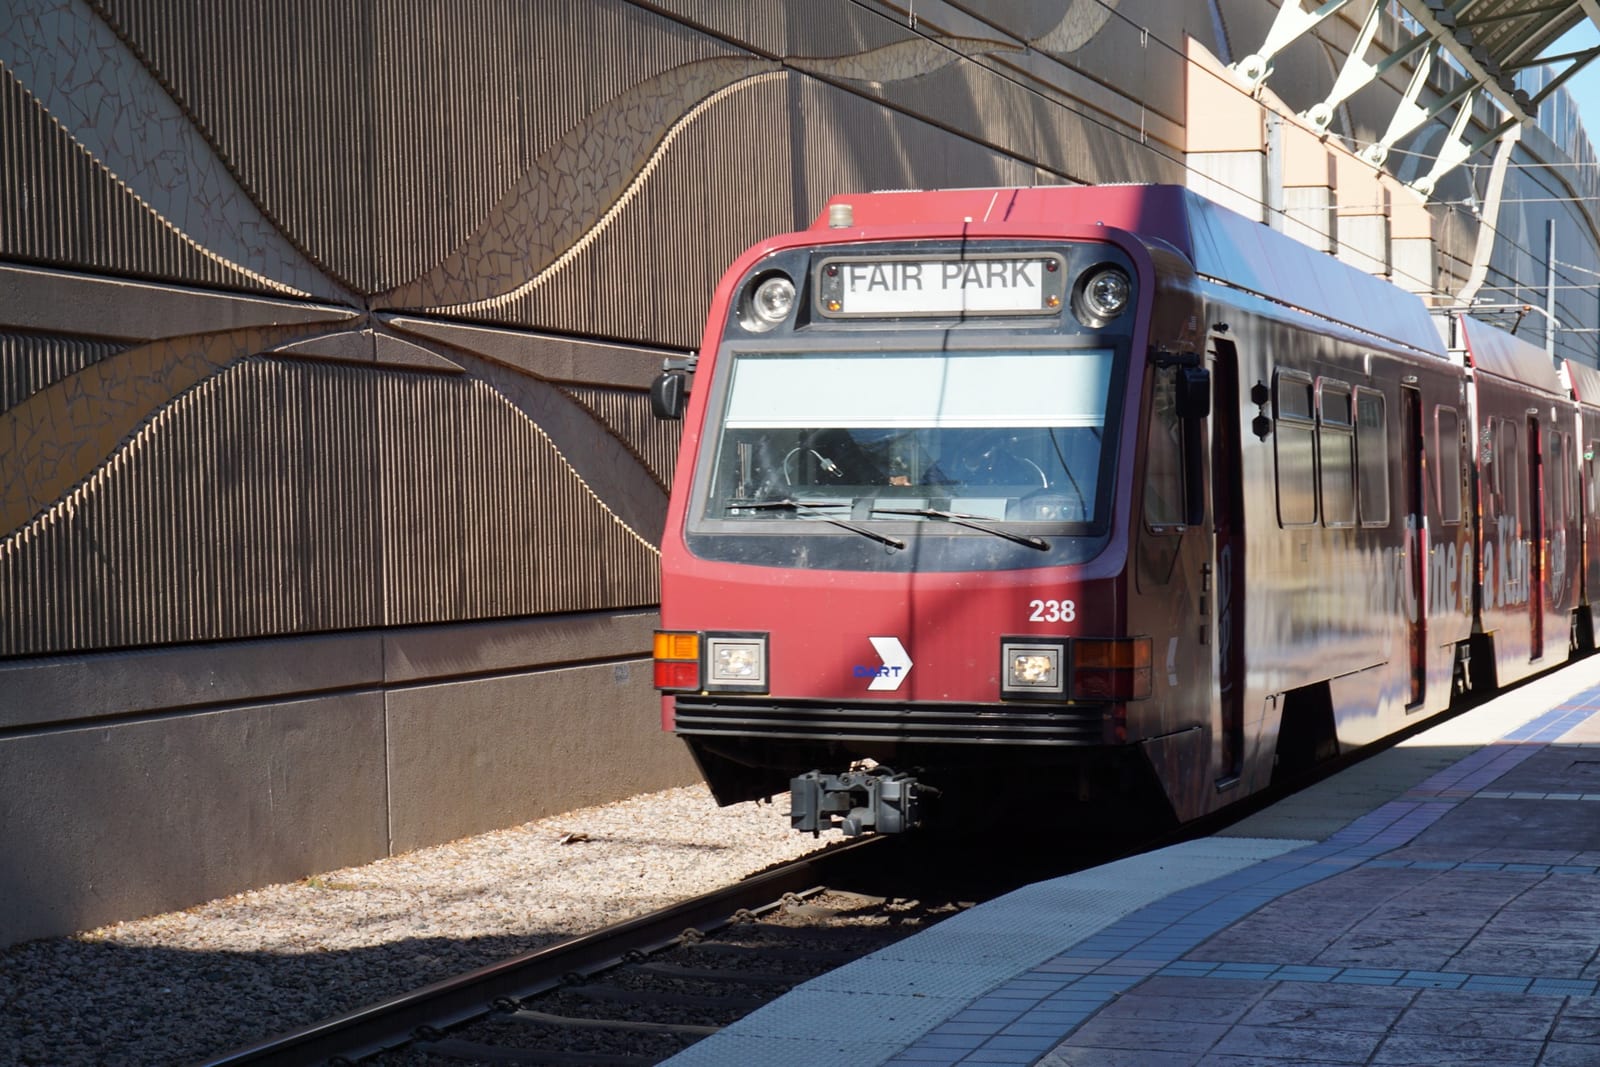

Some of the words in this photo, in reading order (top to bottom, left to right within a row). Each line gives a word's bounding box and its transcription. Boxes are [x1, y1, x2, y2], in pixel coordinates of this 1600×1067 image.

[850, 264, 923, 292] FAIR
[941, 260, 1035, 290] PARK
[1029, 600, 1076, 622] 238
[853, 666, 902, 677] DART
